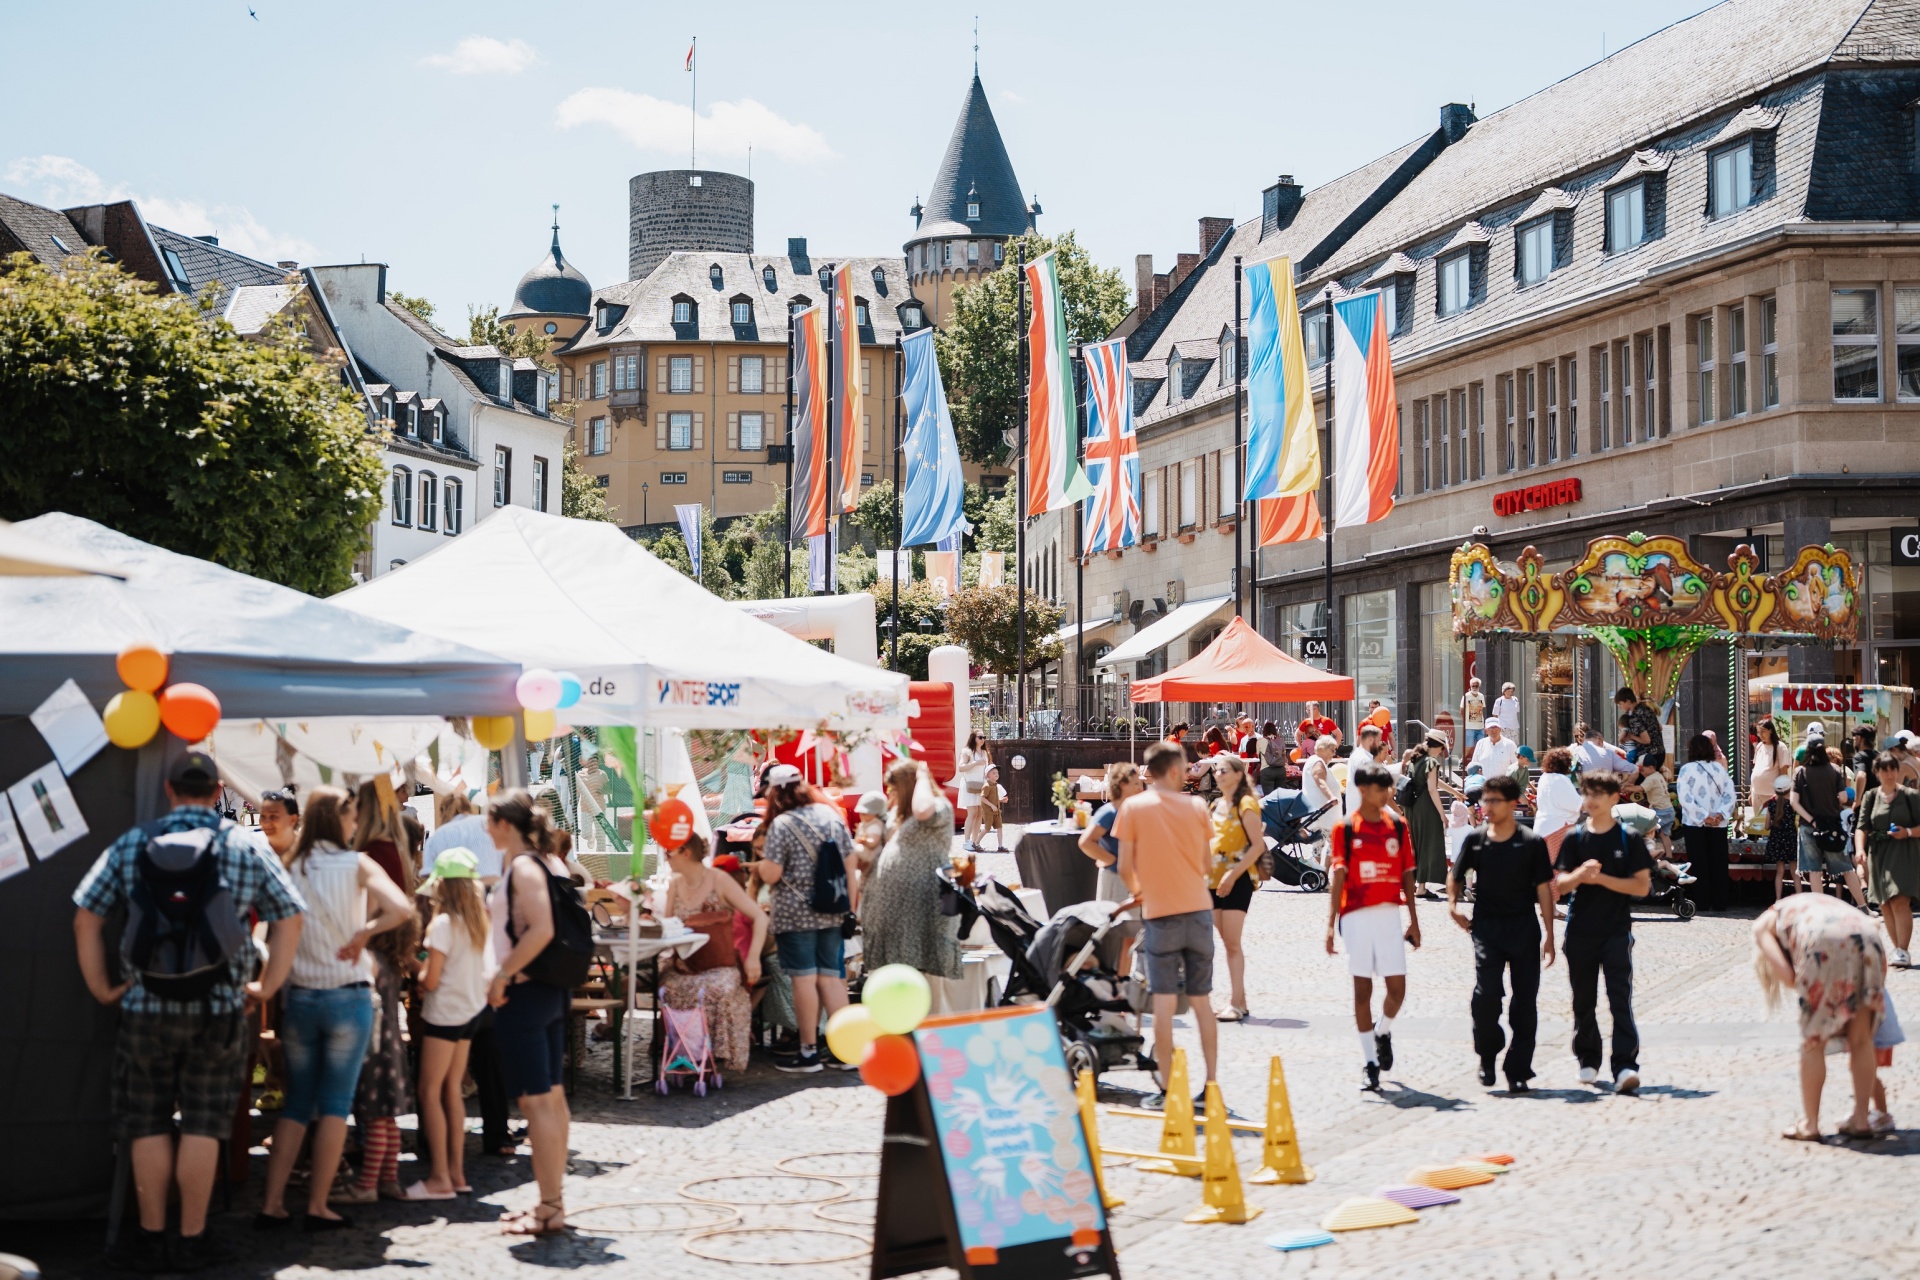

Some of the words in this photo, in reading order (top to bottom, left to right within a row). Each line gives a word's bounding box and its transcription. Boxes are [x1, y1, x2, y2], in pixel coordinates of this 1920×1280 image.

[1493, 489, 1524, 517] CITY
[1524, 478, 1582, 510] CENTER
[1306, 641, 1327, 655] C&A
[672, 680, 741, 706] INTERSPORT
[1782, 688, 1865, 712] KASSE
